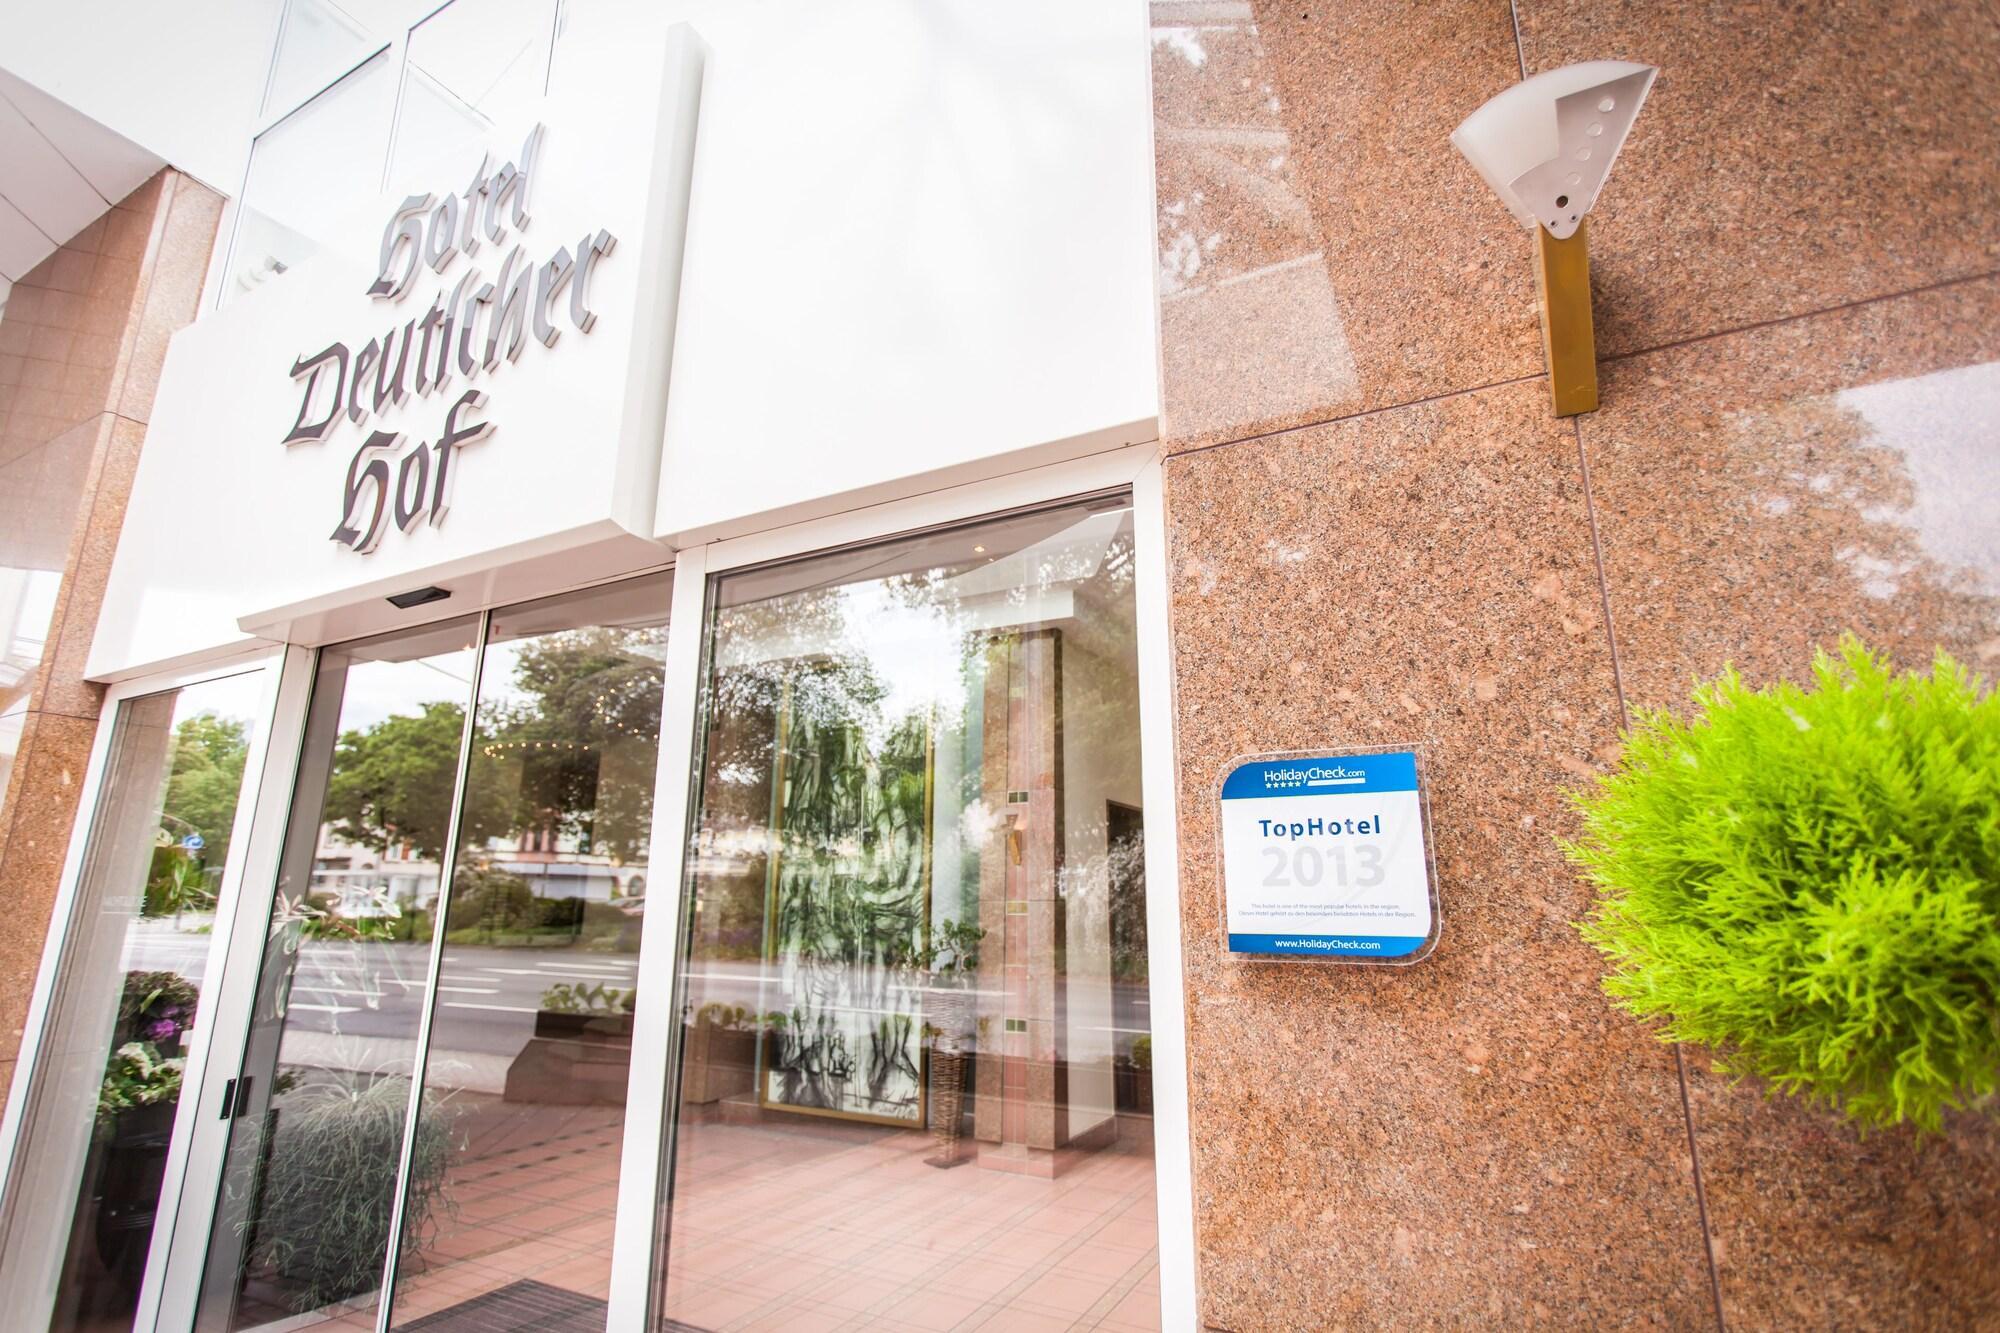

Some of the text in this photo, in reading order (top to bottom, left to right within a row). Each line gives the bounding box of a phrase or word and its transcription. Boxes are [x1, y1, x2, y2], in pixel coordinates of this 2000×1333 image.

[366, 122, 545, 299] Hotel
[329, 389, 497, 555] Hof
[1264, 766, 1365, 783] HolidayCheck.com
[1259, 815, 1380, 841] TopHotel
[1262, 845, 1385, 887] 2013
[1275, 939, 1381, 950] www.HolidayCheck.com
